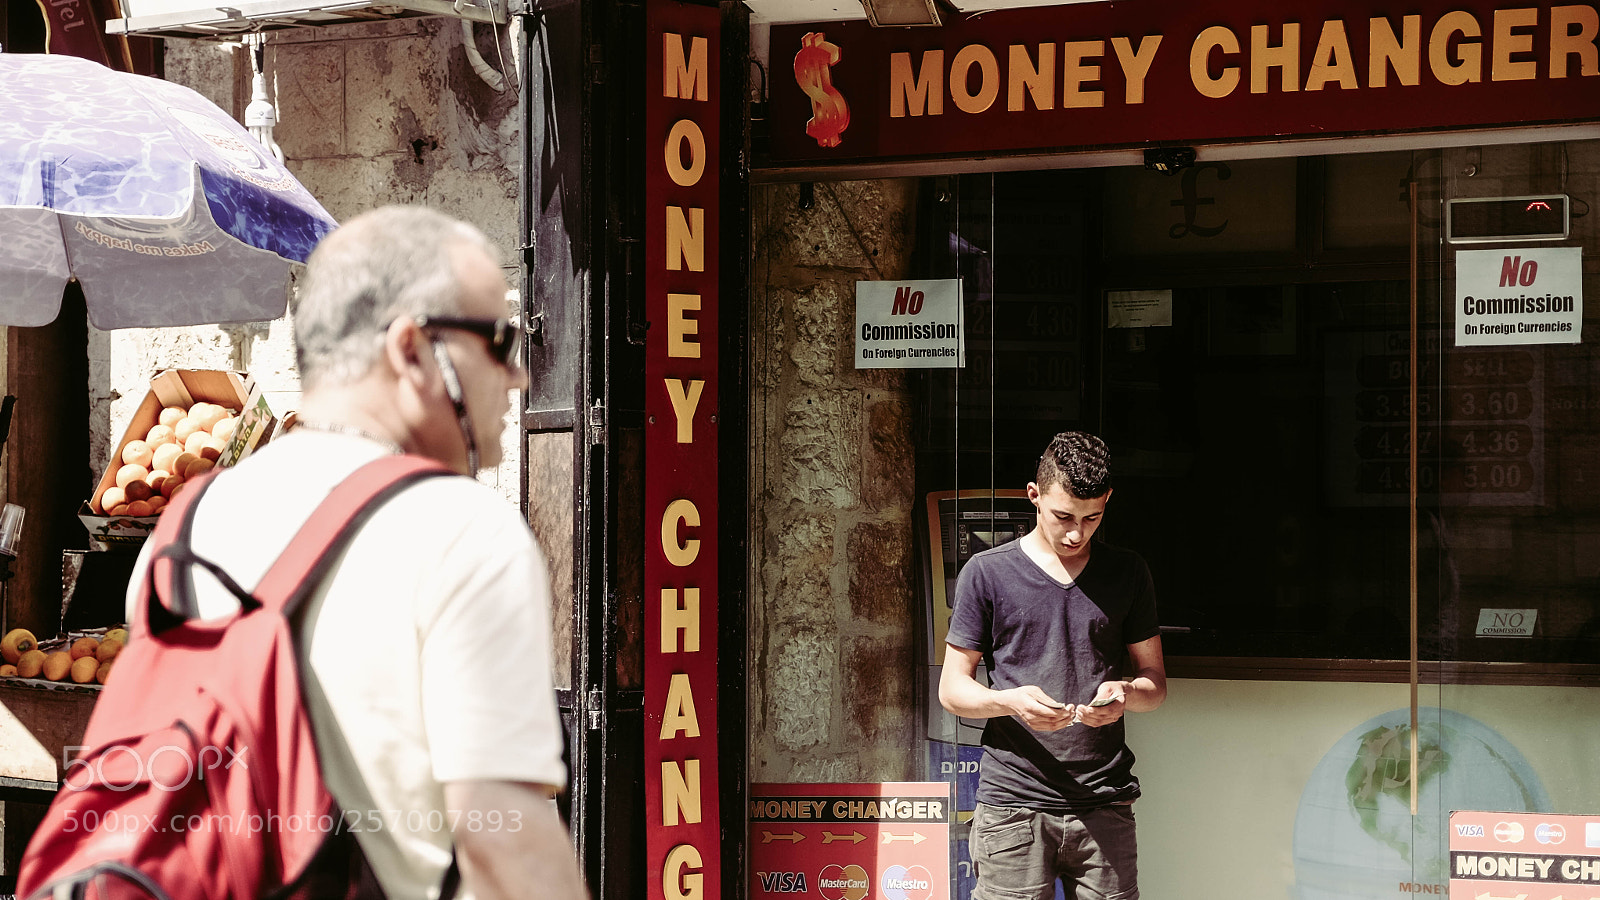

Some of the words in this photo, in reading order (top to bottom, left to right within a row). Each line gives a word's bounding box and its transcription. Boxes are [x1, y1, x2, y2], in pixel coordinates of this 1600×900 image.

[890, 34, 1164, 118] MONEY
[1189, 4, 1600, 99] CHANGER
[662, 32, 709, 444] MONEY
[1498, 255, 1538, 287] No
[891, 286, 925, 315] No
[1463, 293, 1574, 315] Commission
[861, 321, 956, 341] Commission
[1464, 323, 1478, 335] On
[1479, 321, 1515, 335] Foreign
[1517, 320, 1572, 334] Currencies
[862, 348, 873, 358] On
[875, 348, 906, 359] Foreign
[908, 347, 955, 358] Currencies
[1463, 357, 1508, 377] SELL
[1461, 391, 1519, 415] 3.60
[1462, 429, 1520, 453] 4.36
[1463, 464, 1521, 488] 5.00
[1492, 612, 1524, 628] NO
[659, 499, 704, 900] CHANG
[750, 800, 827, 819] MONEY
[832, 800, 943, 819] CHANGER
[1455, 823, 1485, 837] VISA
[1456, 855, 1555, 878] MONEY
[1561, 859, 1600, 881] CH
[756, 871, 808, 893] VISA
[820, 878, 867, 889] MasterCard
[886, 878, 929, 890] Maestro
[1399, 882, 1449, 895] MONEY
